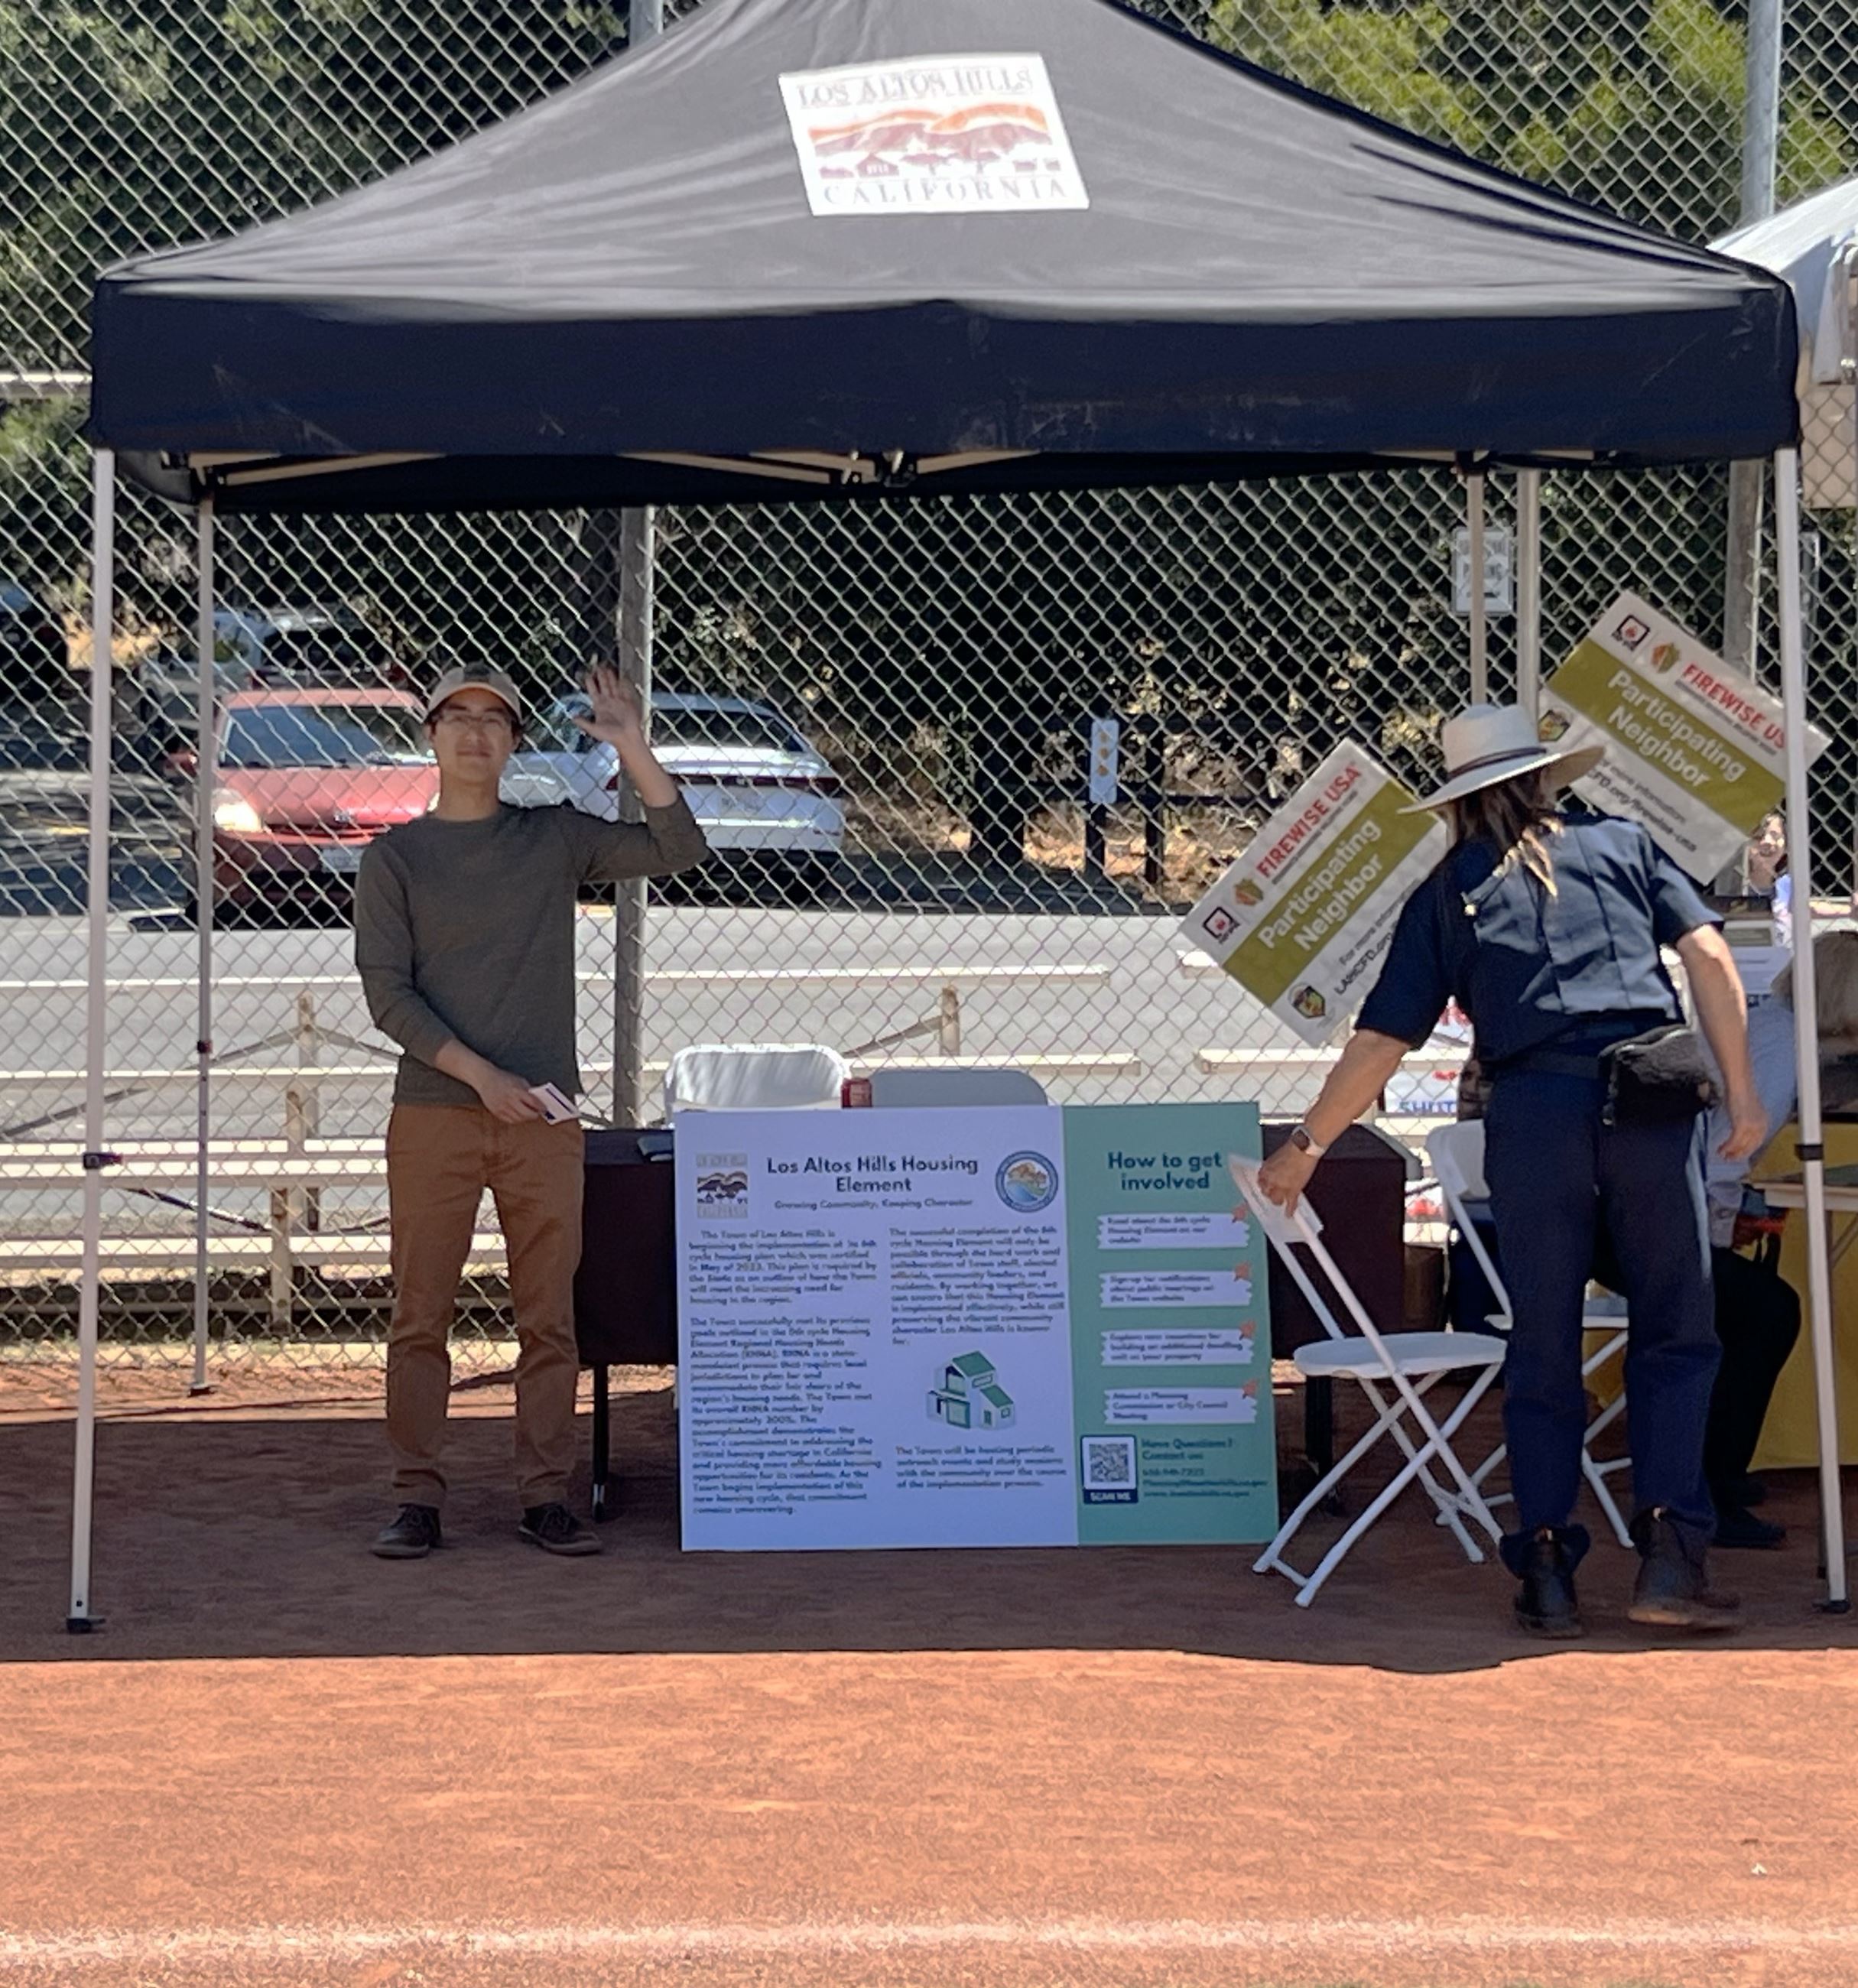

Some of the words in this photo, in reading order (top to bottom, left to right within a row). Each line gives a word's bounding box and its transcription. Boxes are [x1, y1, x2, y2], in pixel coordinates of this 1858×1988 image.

[796, 83, 850, 109] LOS
[856, 70, 950, 105] ALTOS
[954, 66, 1034, 97] HILLS
[823, 178, 1068, 205] CALIFORNIA
[1607, 669, 1746, 783] Participating
[1683, 664, 1766, 731] FIREWISE
[1762, 723, 1785, 749] US
[1607, 704, 1711, 788] Neighbor
[1256, 799, 1330, 878] FIREWISE
[1324, 765, 1362, 802] USA
[1257, 820, 1382, 949] Participating
[1293, 853, 1382, 951] Neighbor
[767, 1156, 798, 1174] Los
[803, 1156, 853, 1174] Altos
[857, 1155, 897, 1172] Hills
[901, 1154, 979, 1175] Housing
[836, 1176, 912, 1193] Element
[1108, 1152, 1156, 1169] How
[1162, 1152, 1182, 1168] to
[1189, 1152, 1223, 1172] get
[1122, 1171, 1210, 1191] involved
